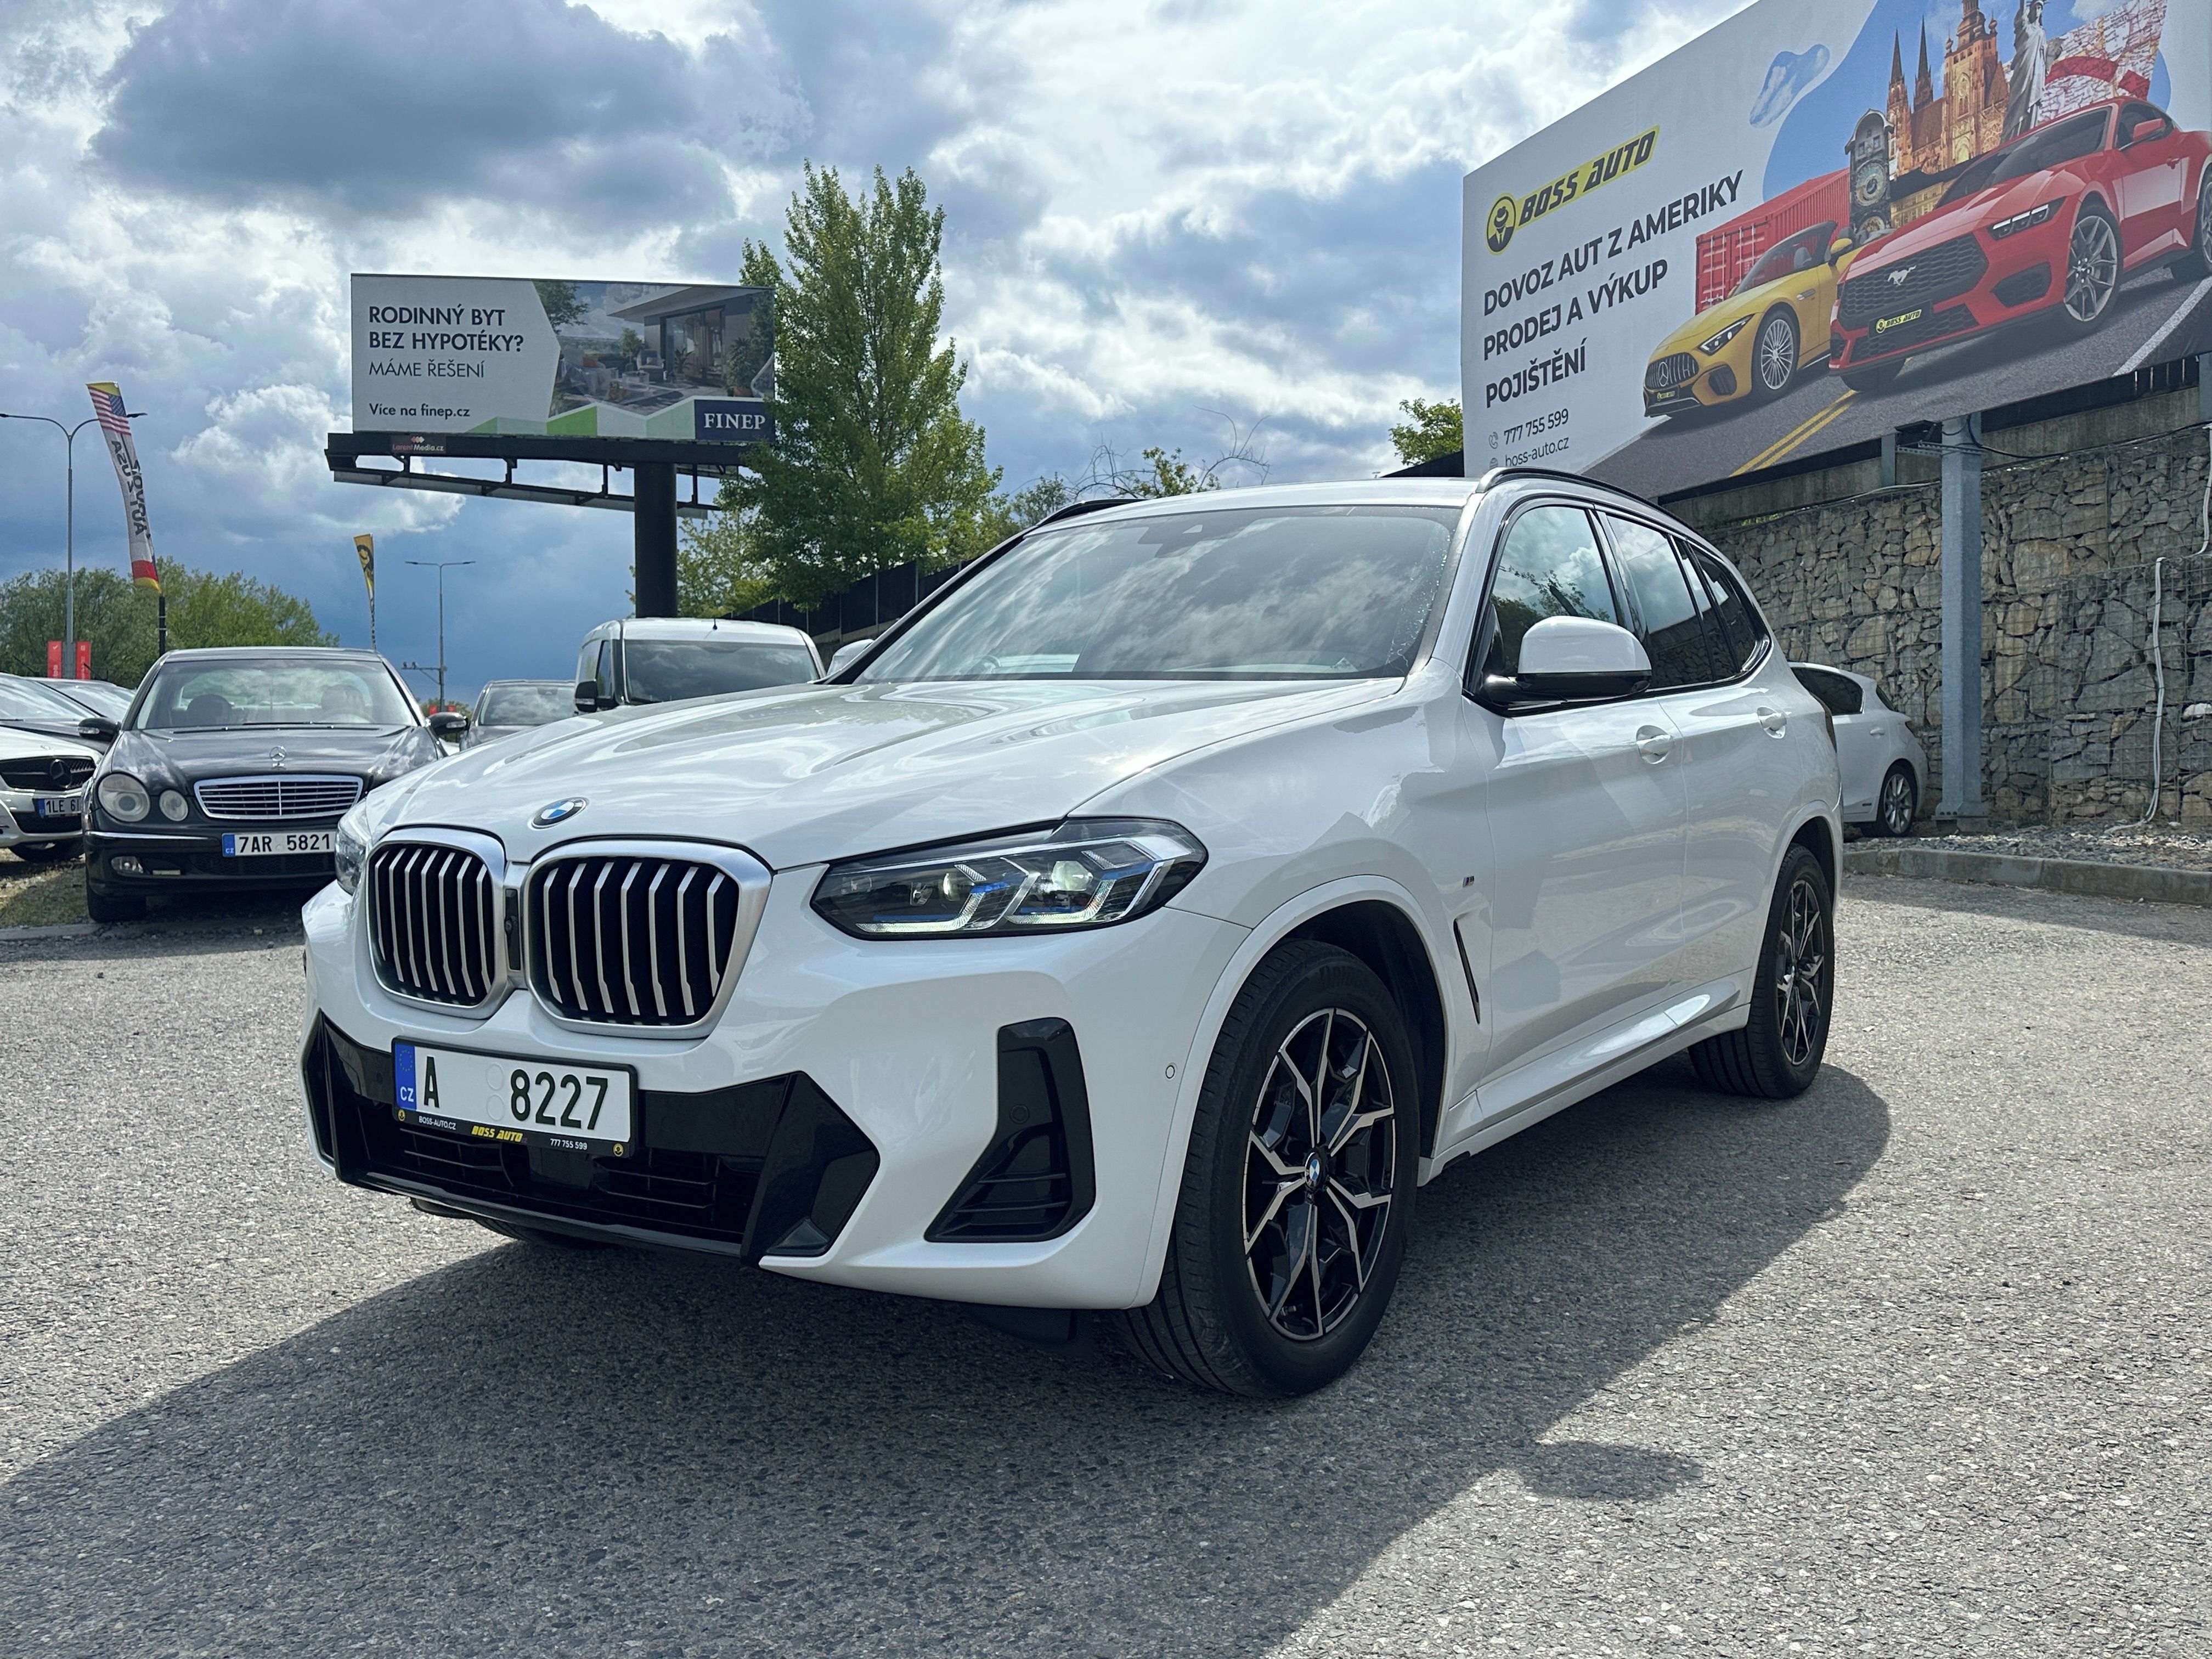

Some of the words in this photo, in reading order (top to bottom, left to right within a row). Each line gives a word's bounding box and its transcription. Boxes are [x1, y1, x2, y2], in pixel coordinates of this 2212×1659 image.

[1519, 171, 1580, 226] BOSS
[1583, 131, 1657, 193] AUTO
[1483, 259, 1554, 316] DOVOZ
[1558, 236, 1604, 281] AUT
[1607, 227, 1623, 258] Z
[1627, 170, 1745, 250] AMERIKY
[369, 303, 465, 326] RODINNÝ
[471, 309, 505, 326] BYT
[1483, 307, 1561, 360] PRODEJ
[1567, 301, 1583, 325] A
[1589, 258, 1667, 314] VÝKUP
[1886, 317, 1901, 326] BOSS
[1903, 311, 1920, 321] AUTO
[369, 331, 404, 349] BEZ
[411, 329, 524, 352] HYPOTÉKY?
[369, 358, 422, 376] MÁME
[427, 358, 485, 378] ŘEŠENÍ
[1486, 337, 1587, 408] POJIŠTĚNÍ
[369, 403, 396, 416] Více
[400, 408, 417, 416] na
[421, 403, 471, 420] finep.cz
[704, 413, 766, 430] FINEP
[1504, 425, 1522, 444] 777
[1526, 417, 1544, 437] 755
[1548, 409, 1568, 429] 599
[1505, 437, 1569, 466] boss-auto.cz
[46, 800, 65, 813] 1LE
[239, 836, 272, 853] 7AR
[286, 834, 330, 851] 5821
[400, 1086, 414, 1102] CZ
[424, 1056, 440, 1108] A
[510, 1069, 608, 1130] 8227
[419, 1115, 456, 1130] BOSS-AUTO.CZ
[471, 1125, 495, 1138] BOSS
[496, 1130, 523, 1142] AUTO
[550, 1138, 560, 1147] 777
[562, 1140, 574, 1148] 755
[575, 1142, 588, 1150] 599
